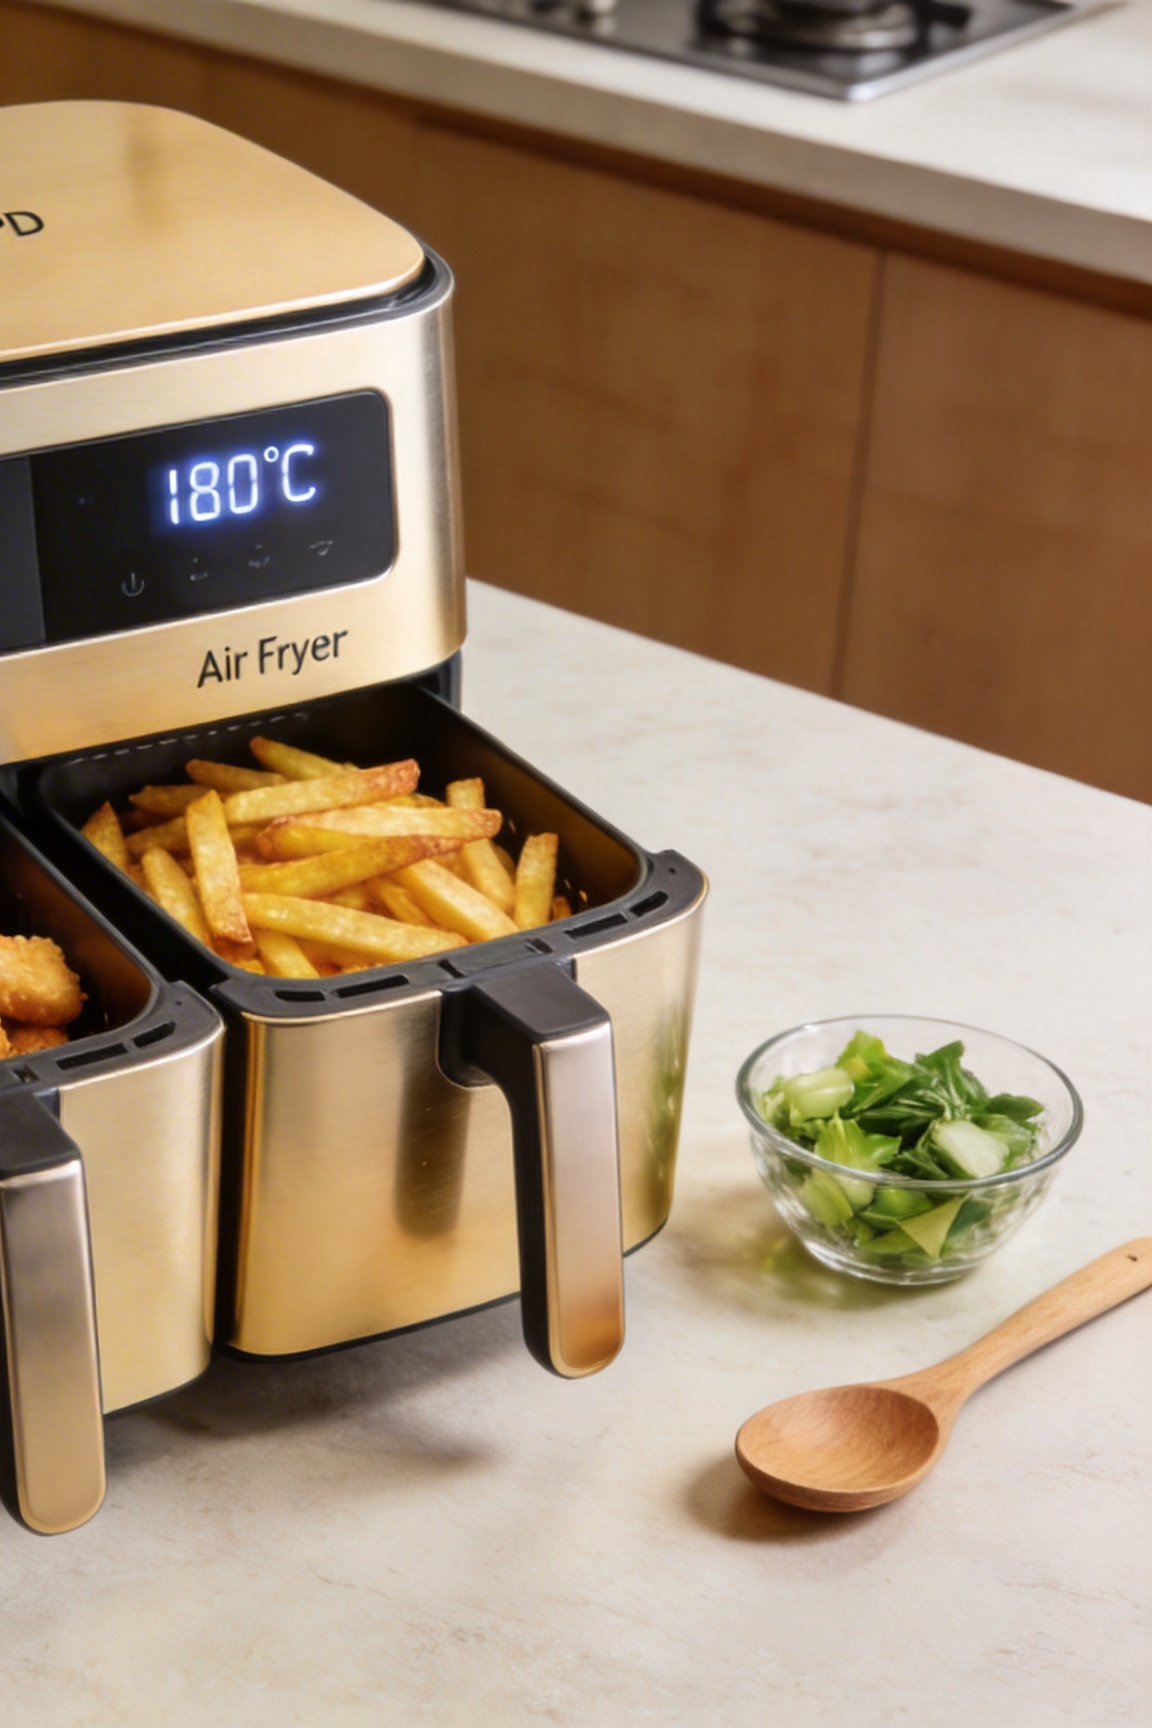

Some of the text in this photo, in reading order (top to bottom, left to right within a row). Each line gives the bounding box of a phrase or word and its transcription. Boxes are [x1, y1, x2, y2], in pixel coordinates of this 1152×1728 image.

[166, 443, 317, 525] 180°C
[196, 629, 349, 688] Air Fryer
